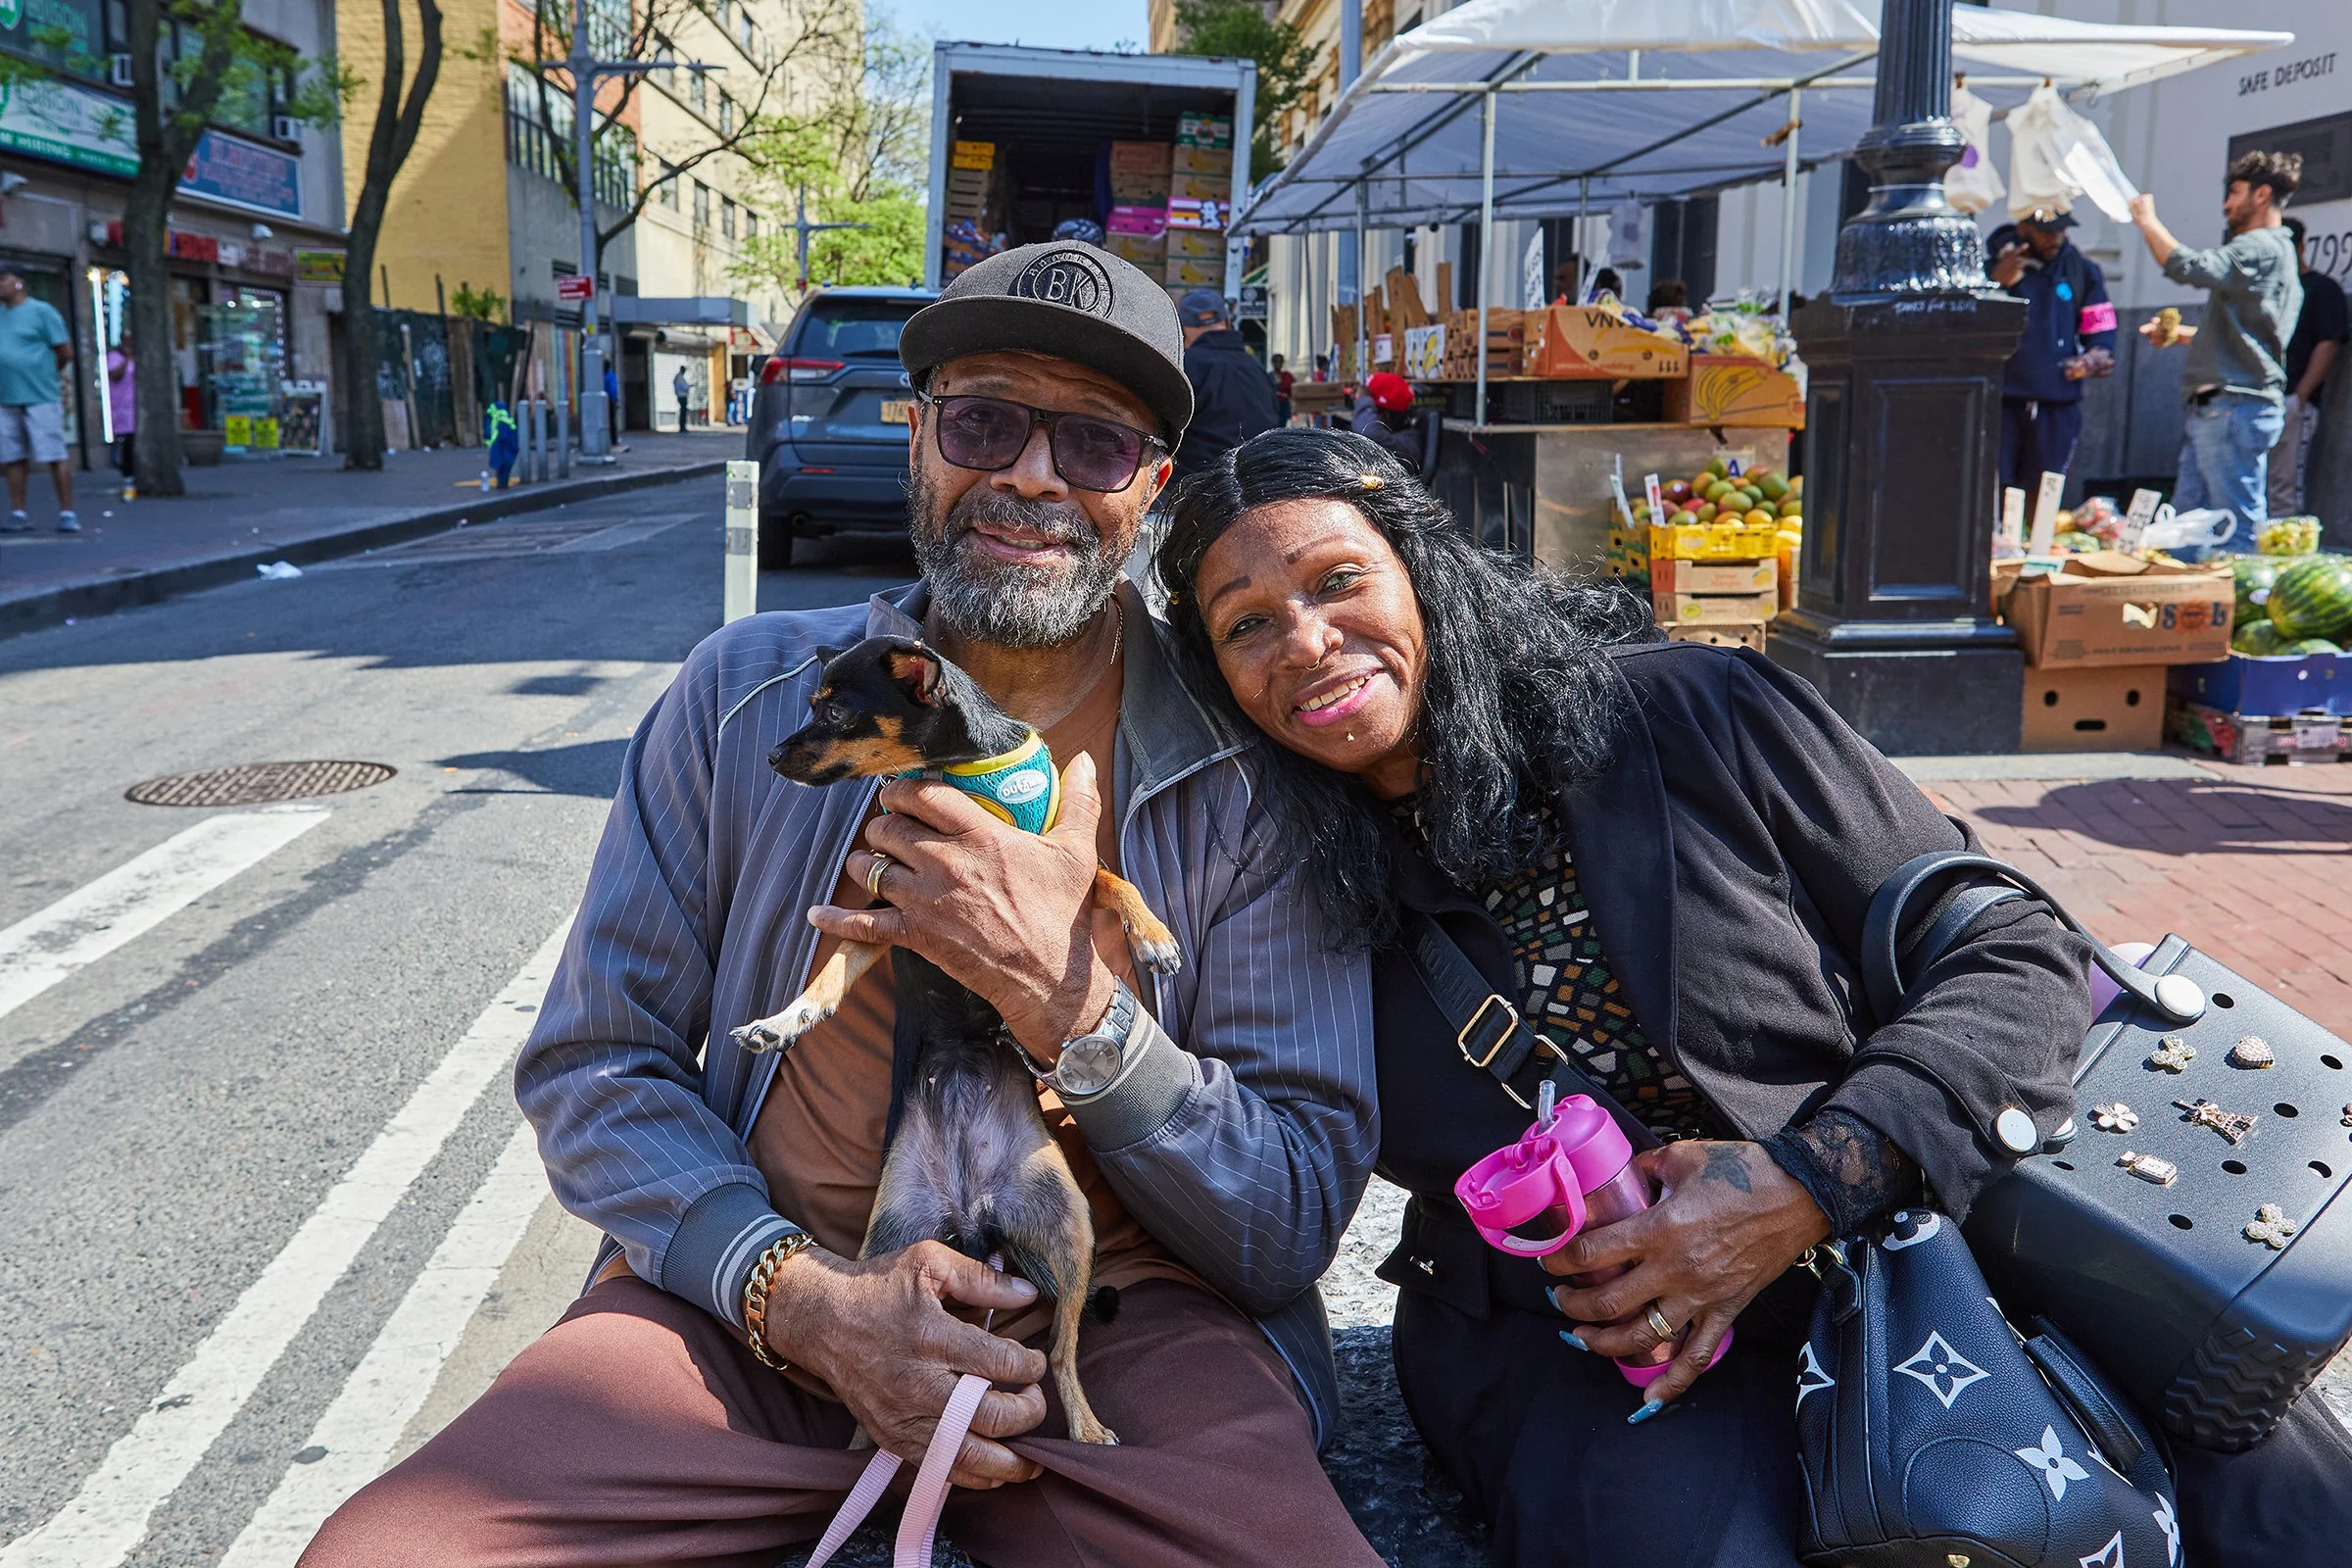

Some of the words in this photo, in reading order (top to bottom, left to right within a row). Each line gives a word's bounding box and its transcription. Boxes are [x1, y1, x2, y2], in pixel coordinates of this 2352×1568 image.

[2238, 70, 2270, 97] SAFE
[2274, 53, 2336, 86] DEPOSIT
[1046, 268, 1091, 310] BK
[1728, 458, 1741, 478] A
